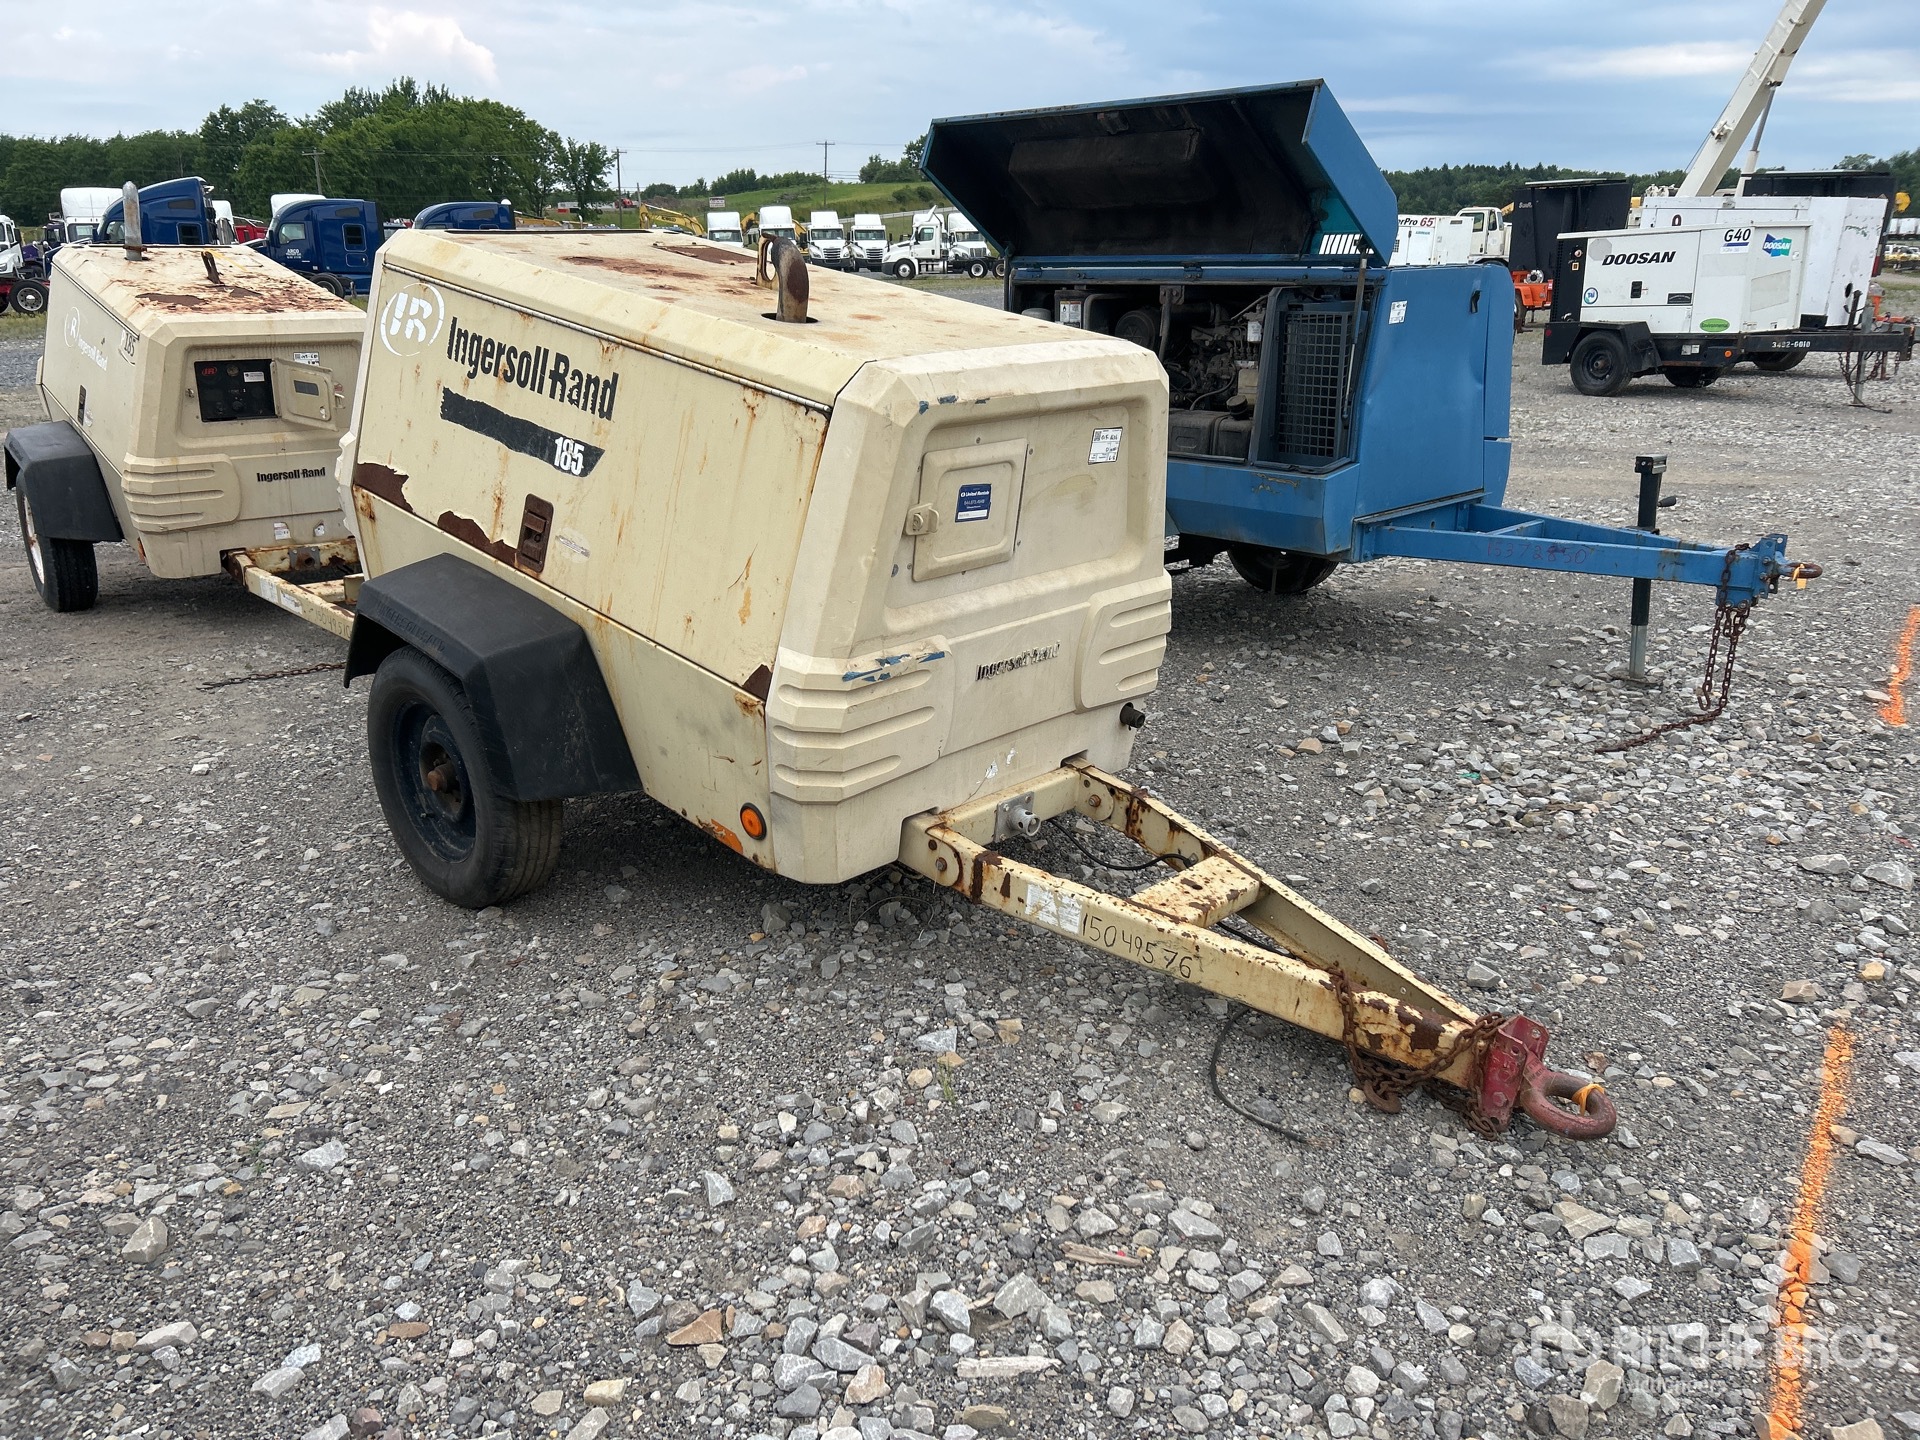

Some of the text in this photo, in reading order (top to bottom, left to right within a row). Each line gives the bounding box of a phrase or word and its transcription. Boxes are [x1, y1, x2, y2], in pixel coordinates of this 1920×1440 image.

[1420, 217, 1435, 227] 65
[1724, 228, 1751, 242] G40
[1763, 241, 1791, 250] DOOSAN
[1602, 251, 1676, 266] DOOSAN
[554, 436, 585, 476] 185
[1082, 912, 1193, 979] 15049576
